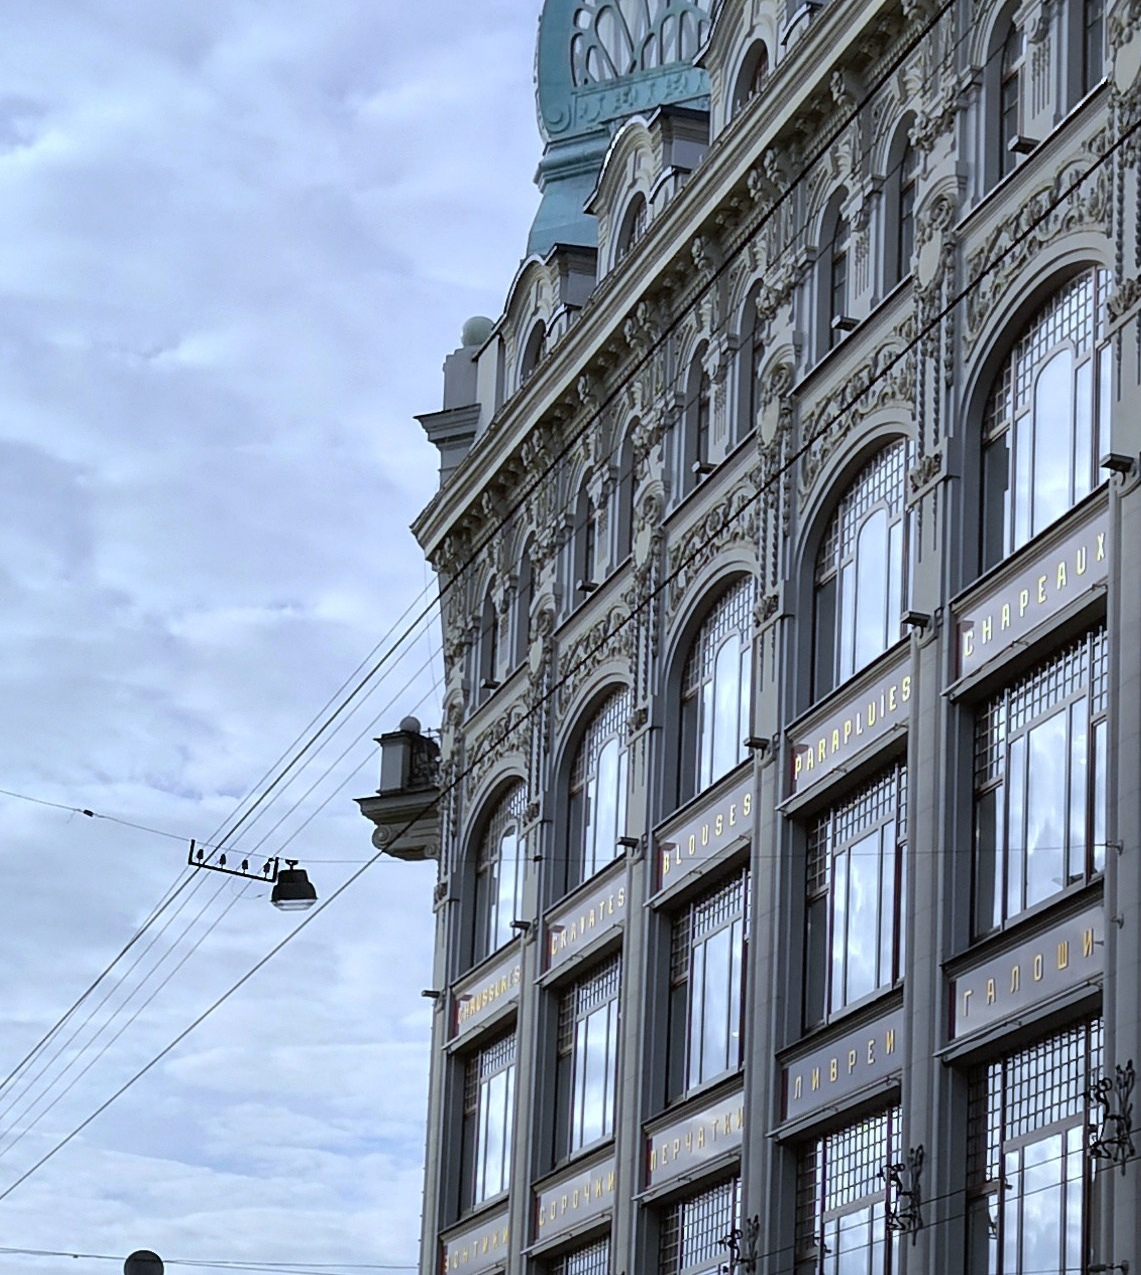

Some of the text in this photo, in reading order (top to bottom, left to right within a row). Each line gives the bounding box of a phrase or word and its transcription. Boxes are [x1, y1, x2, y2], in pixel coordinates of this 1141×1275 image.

[963, 532, 1105, 656] CHAPEAUX
[663, 793, 751, 874] BLOUSES
[551, 887, 625, 955] CRAVATES
[963, 928, 1094, 1016] ГАЛОШИ
[794, 1029, 895, 1100] ЛИВРЕИ
[650, 1107, 744, 1172] ПЕРЧАТКИ
[539, 1171, 615, 1226] СОРОЧКИ
